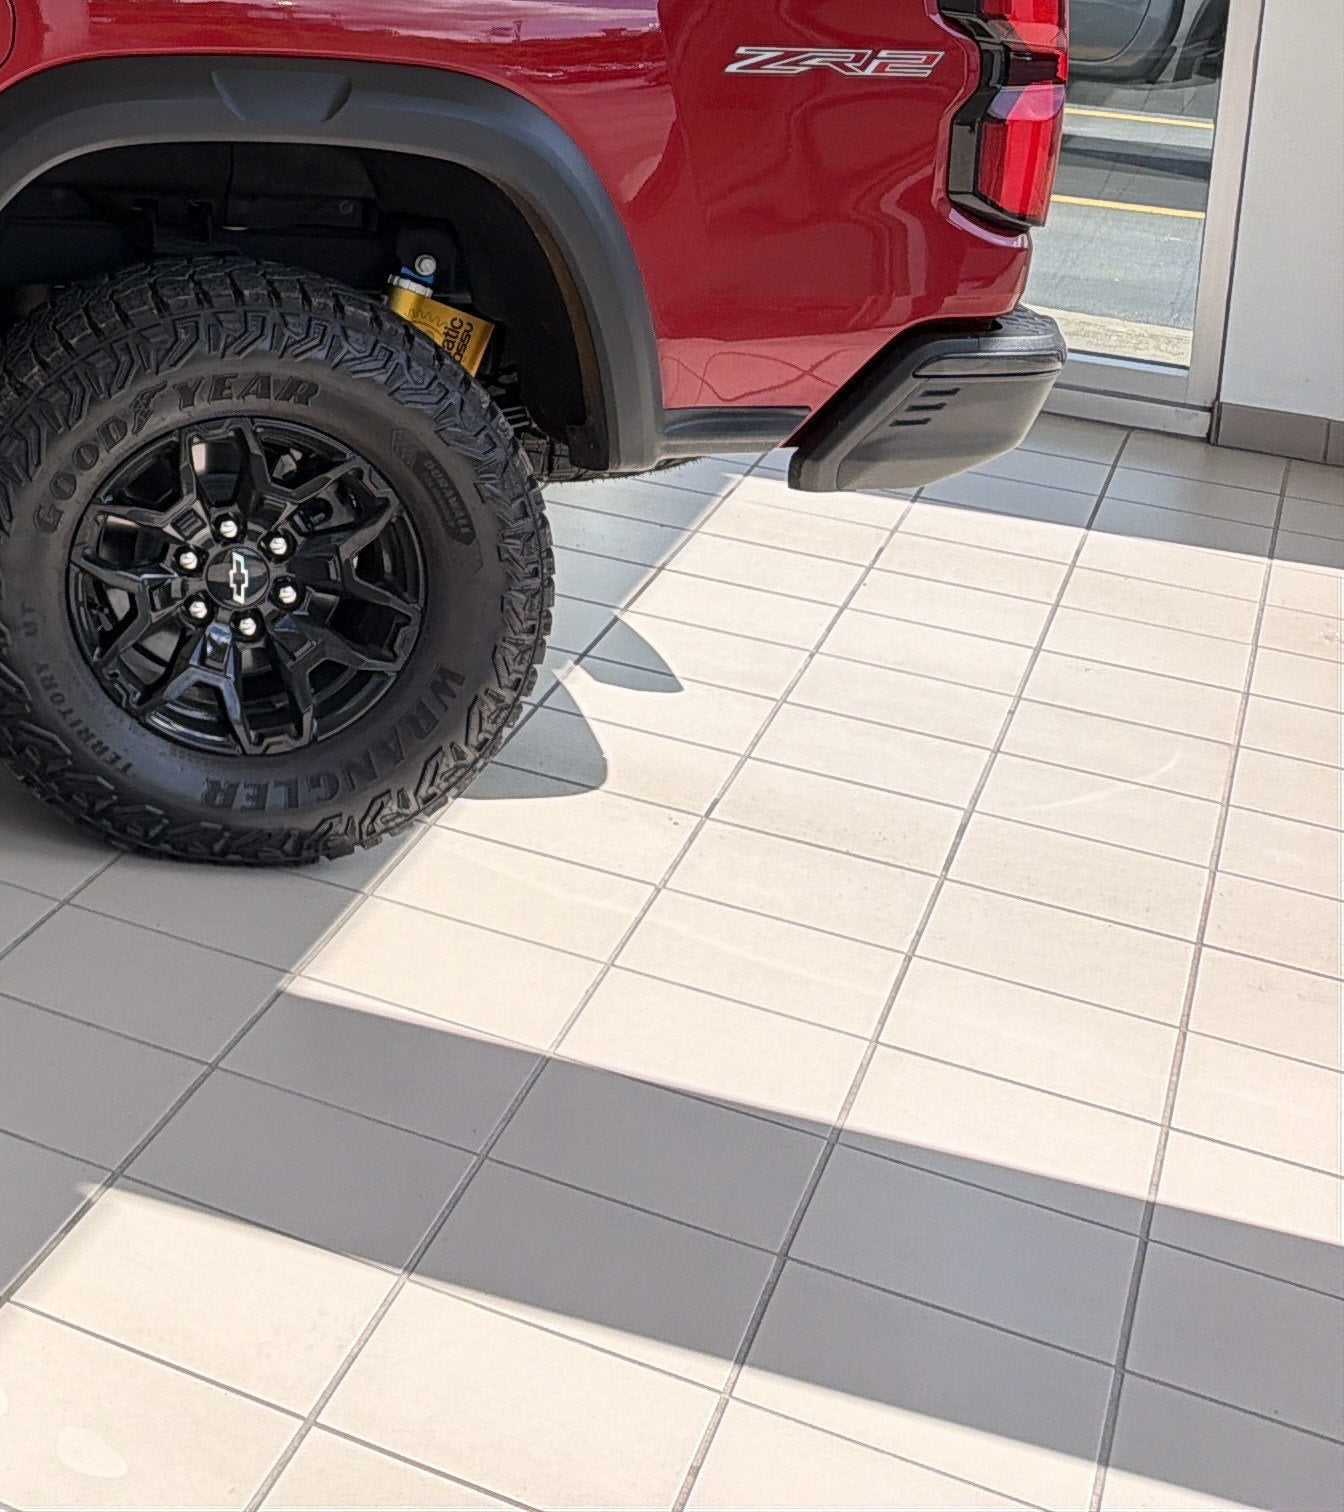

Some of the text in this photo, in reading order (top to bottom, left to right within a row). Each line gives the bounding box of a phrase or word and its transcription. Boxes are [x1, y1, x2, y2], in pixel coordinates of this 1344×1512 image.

[724, 46, 946, 78] ZR2
[442, 317, 463, 352] atic
[200, 662, 466, 811] WRANGLER
